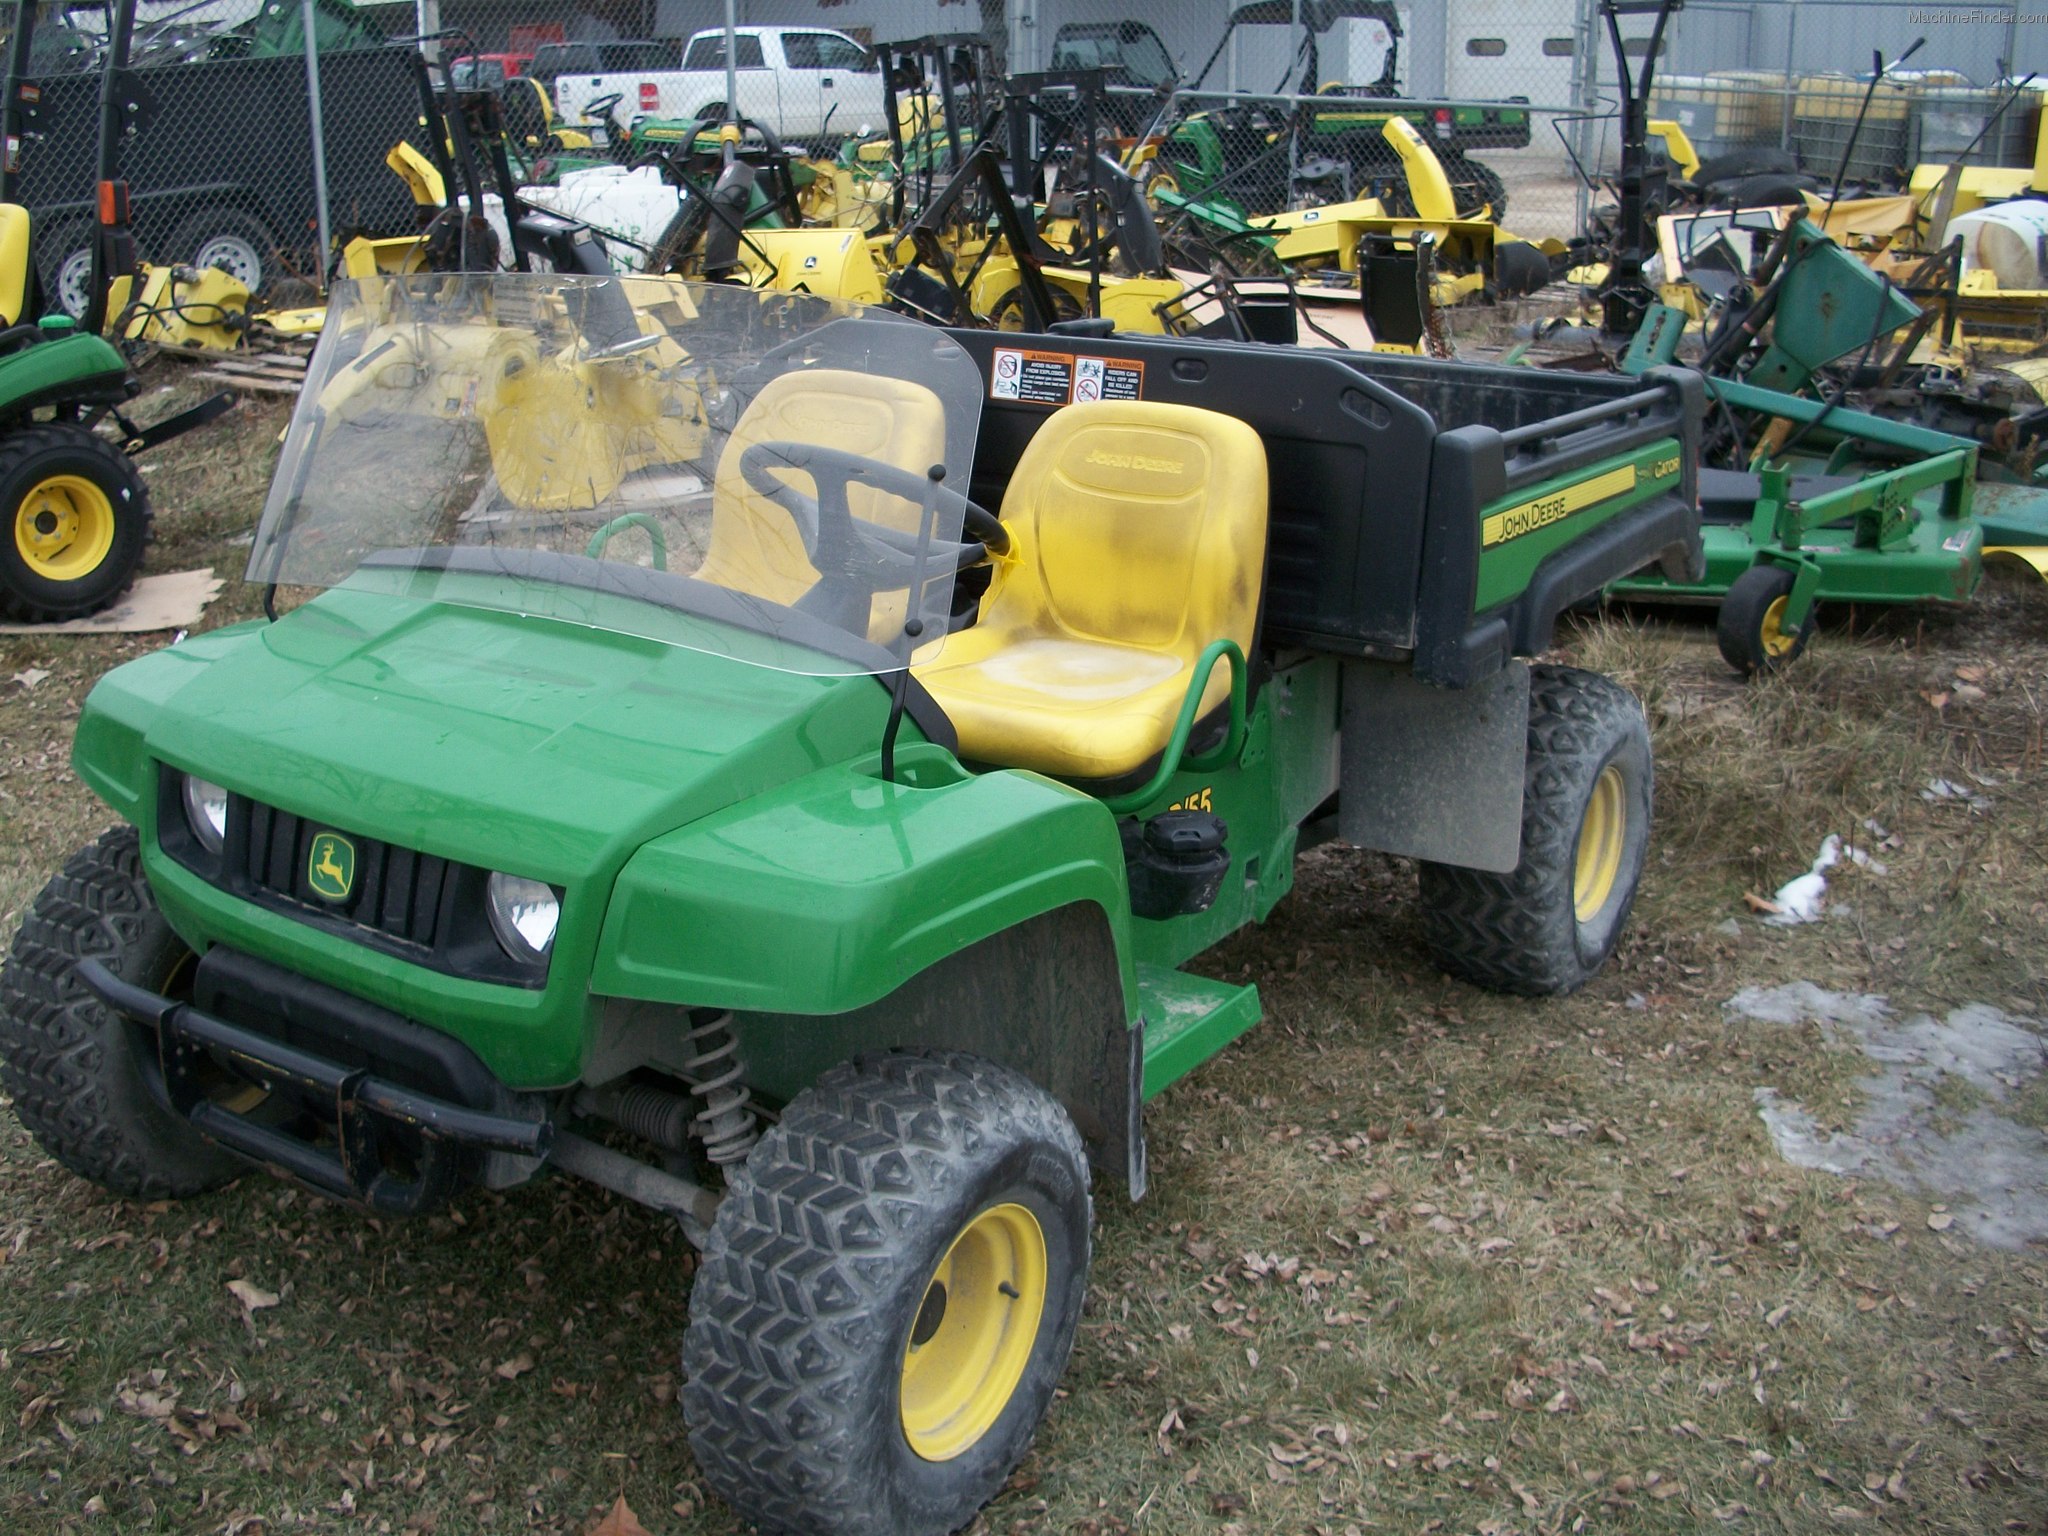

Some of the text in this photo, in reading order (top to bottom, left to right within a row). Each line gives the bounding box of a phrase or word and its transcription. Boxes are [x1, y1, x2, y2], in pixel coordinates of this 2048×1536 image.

[1036, 352, 1066, 361] WARNING
[1112, 360, 1142, 369] WARNING
[1085, 448, 1184, 475] JOHN DEERE
[1654, 456, 1680, 479] GATOR
[1499, 497, 1567, 541] JOHN DEERE
